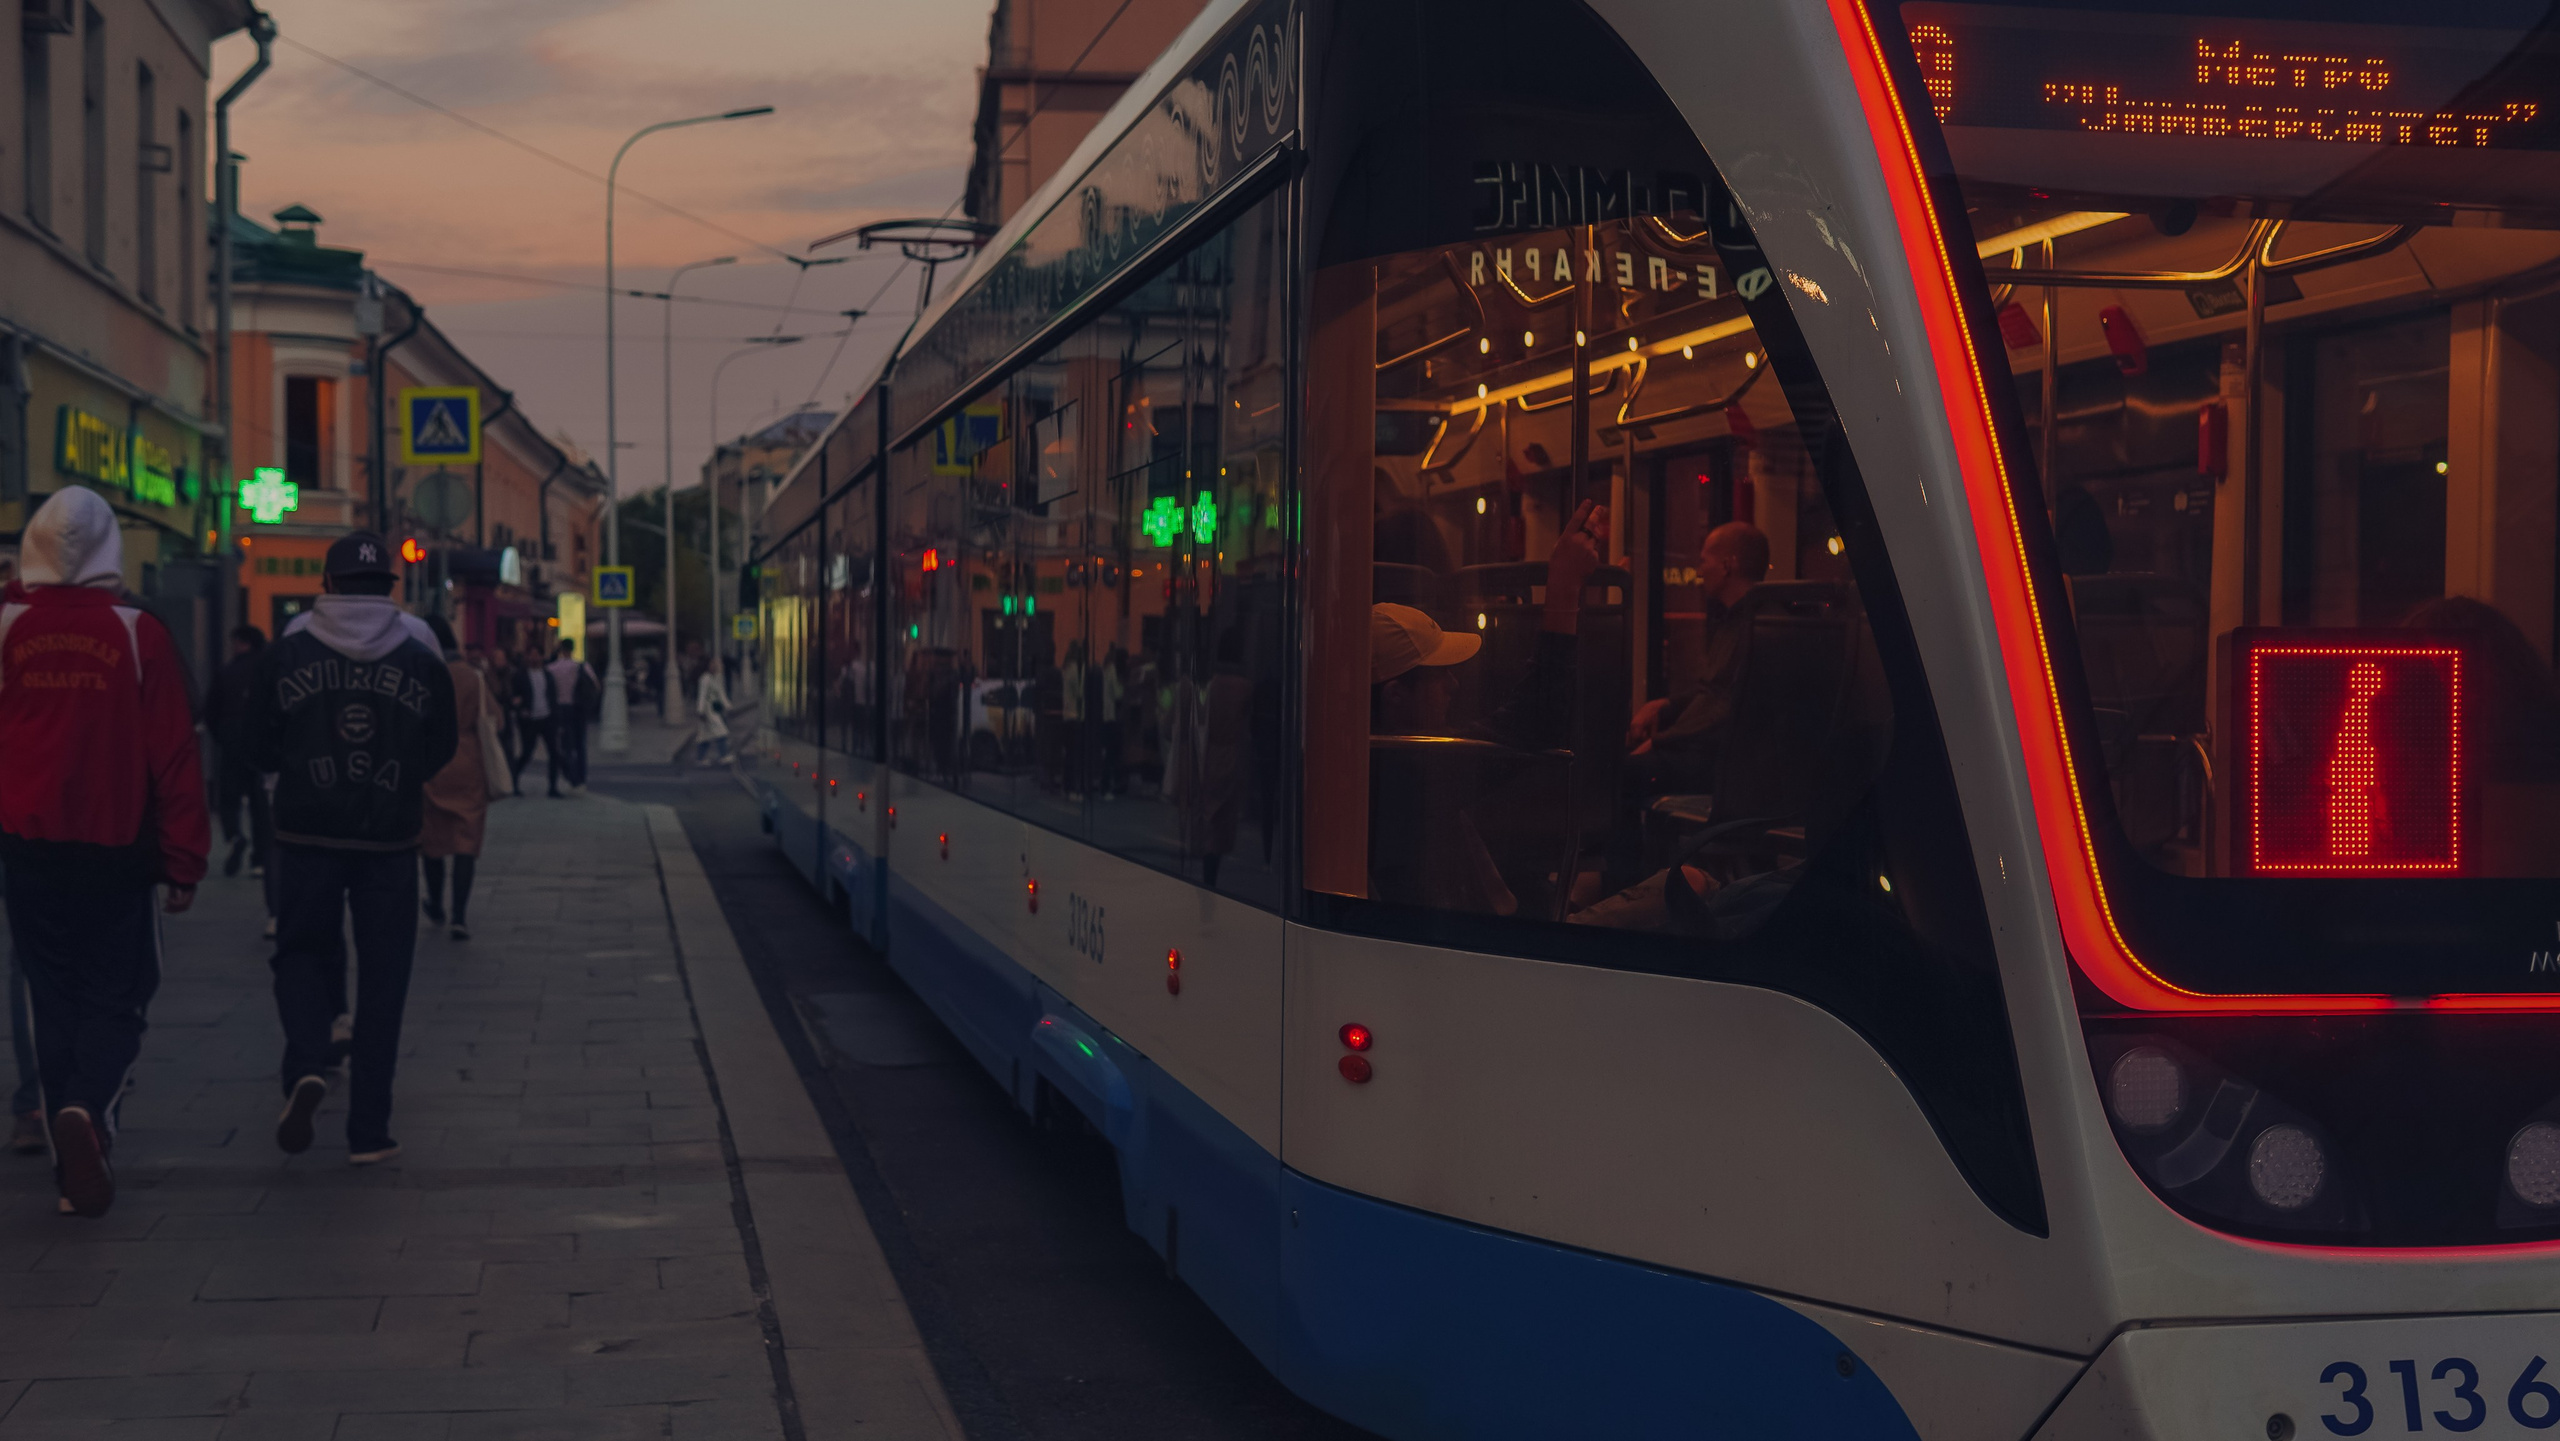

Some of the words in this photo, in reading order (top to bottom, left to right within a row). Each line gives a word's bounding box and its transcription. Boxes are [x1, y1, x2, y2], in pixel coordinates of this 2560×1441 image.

[2197, 39, 2390, 91] Метро
[64, 410, 131, 488] АПТЕКА
[277, 658, 432, 713] AVIREX
[308, 751, 400, 792] USA
[1068, 891, 1104, 964] 31365
